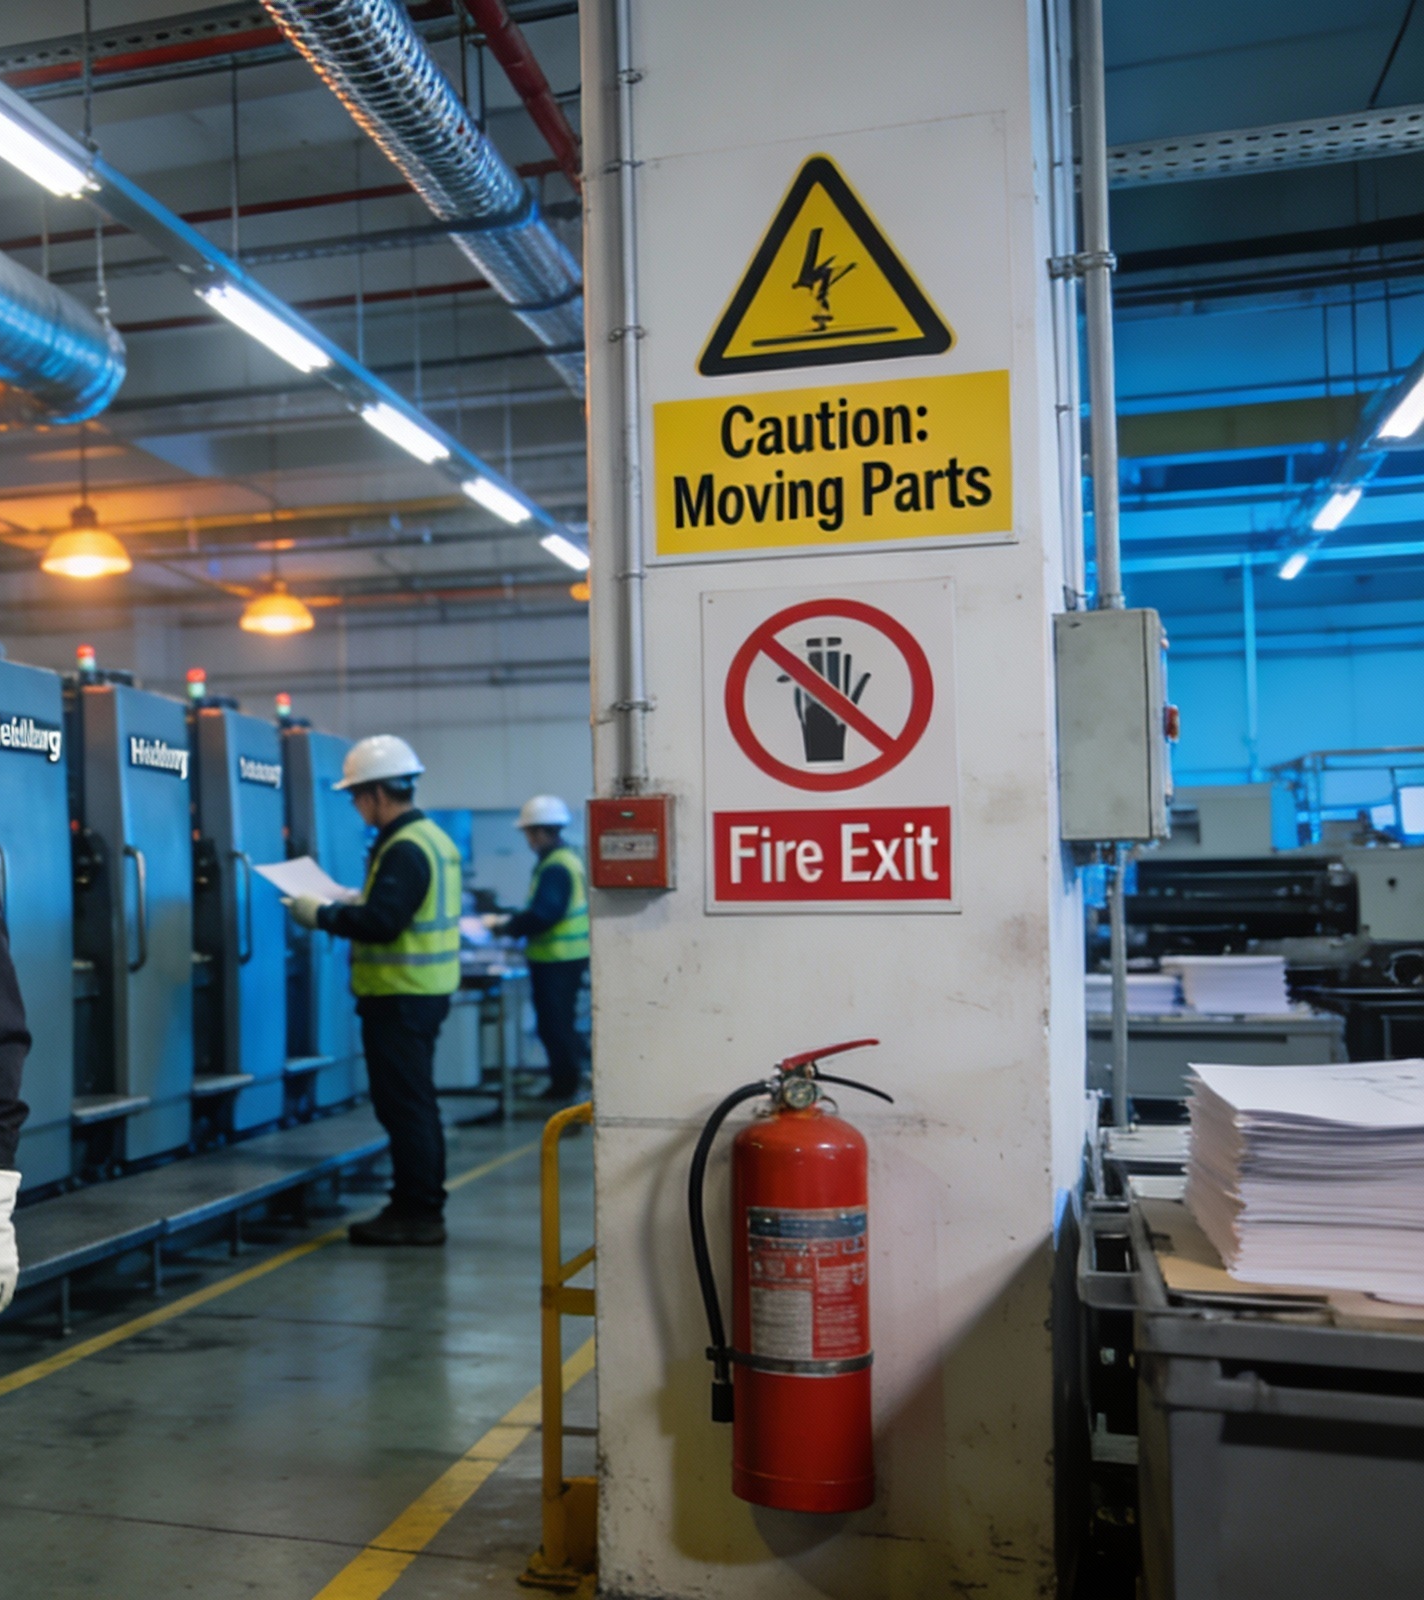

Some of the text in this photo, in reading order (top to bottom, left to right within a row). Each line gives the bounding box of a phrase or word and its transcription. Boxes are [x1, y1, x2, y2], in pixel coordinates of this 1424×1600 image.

[720, 397, 928, 460] Caution:
[673, 457, 993, 532] Moving Parts
[729, 822, 939, 884] Fire Exit
